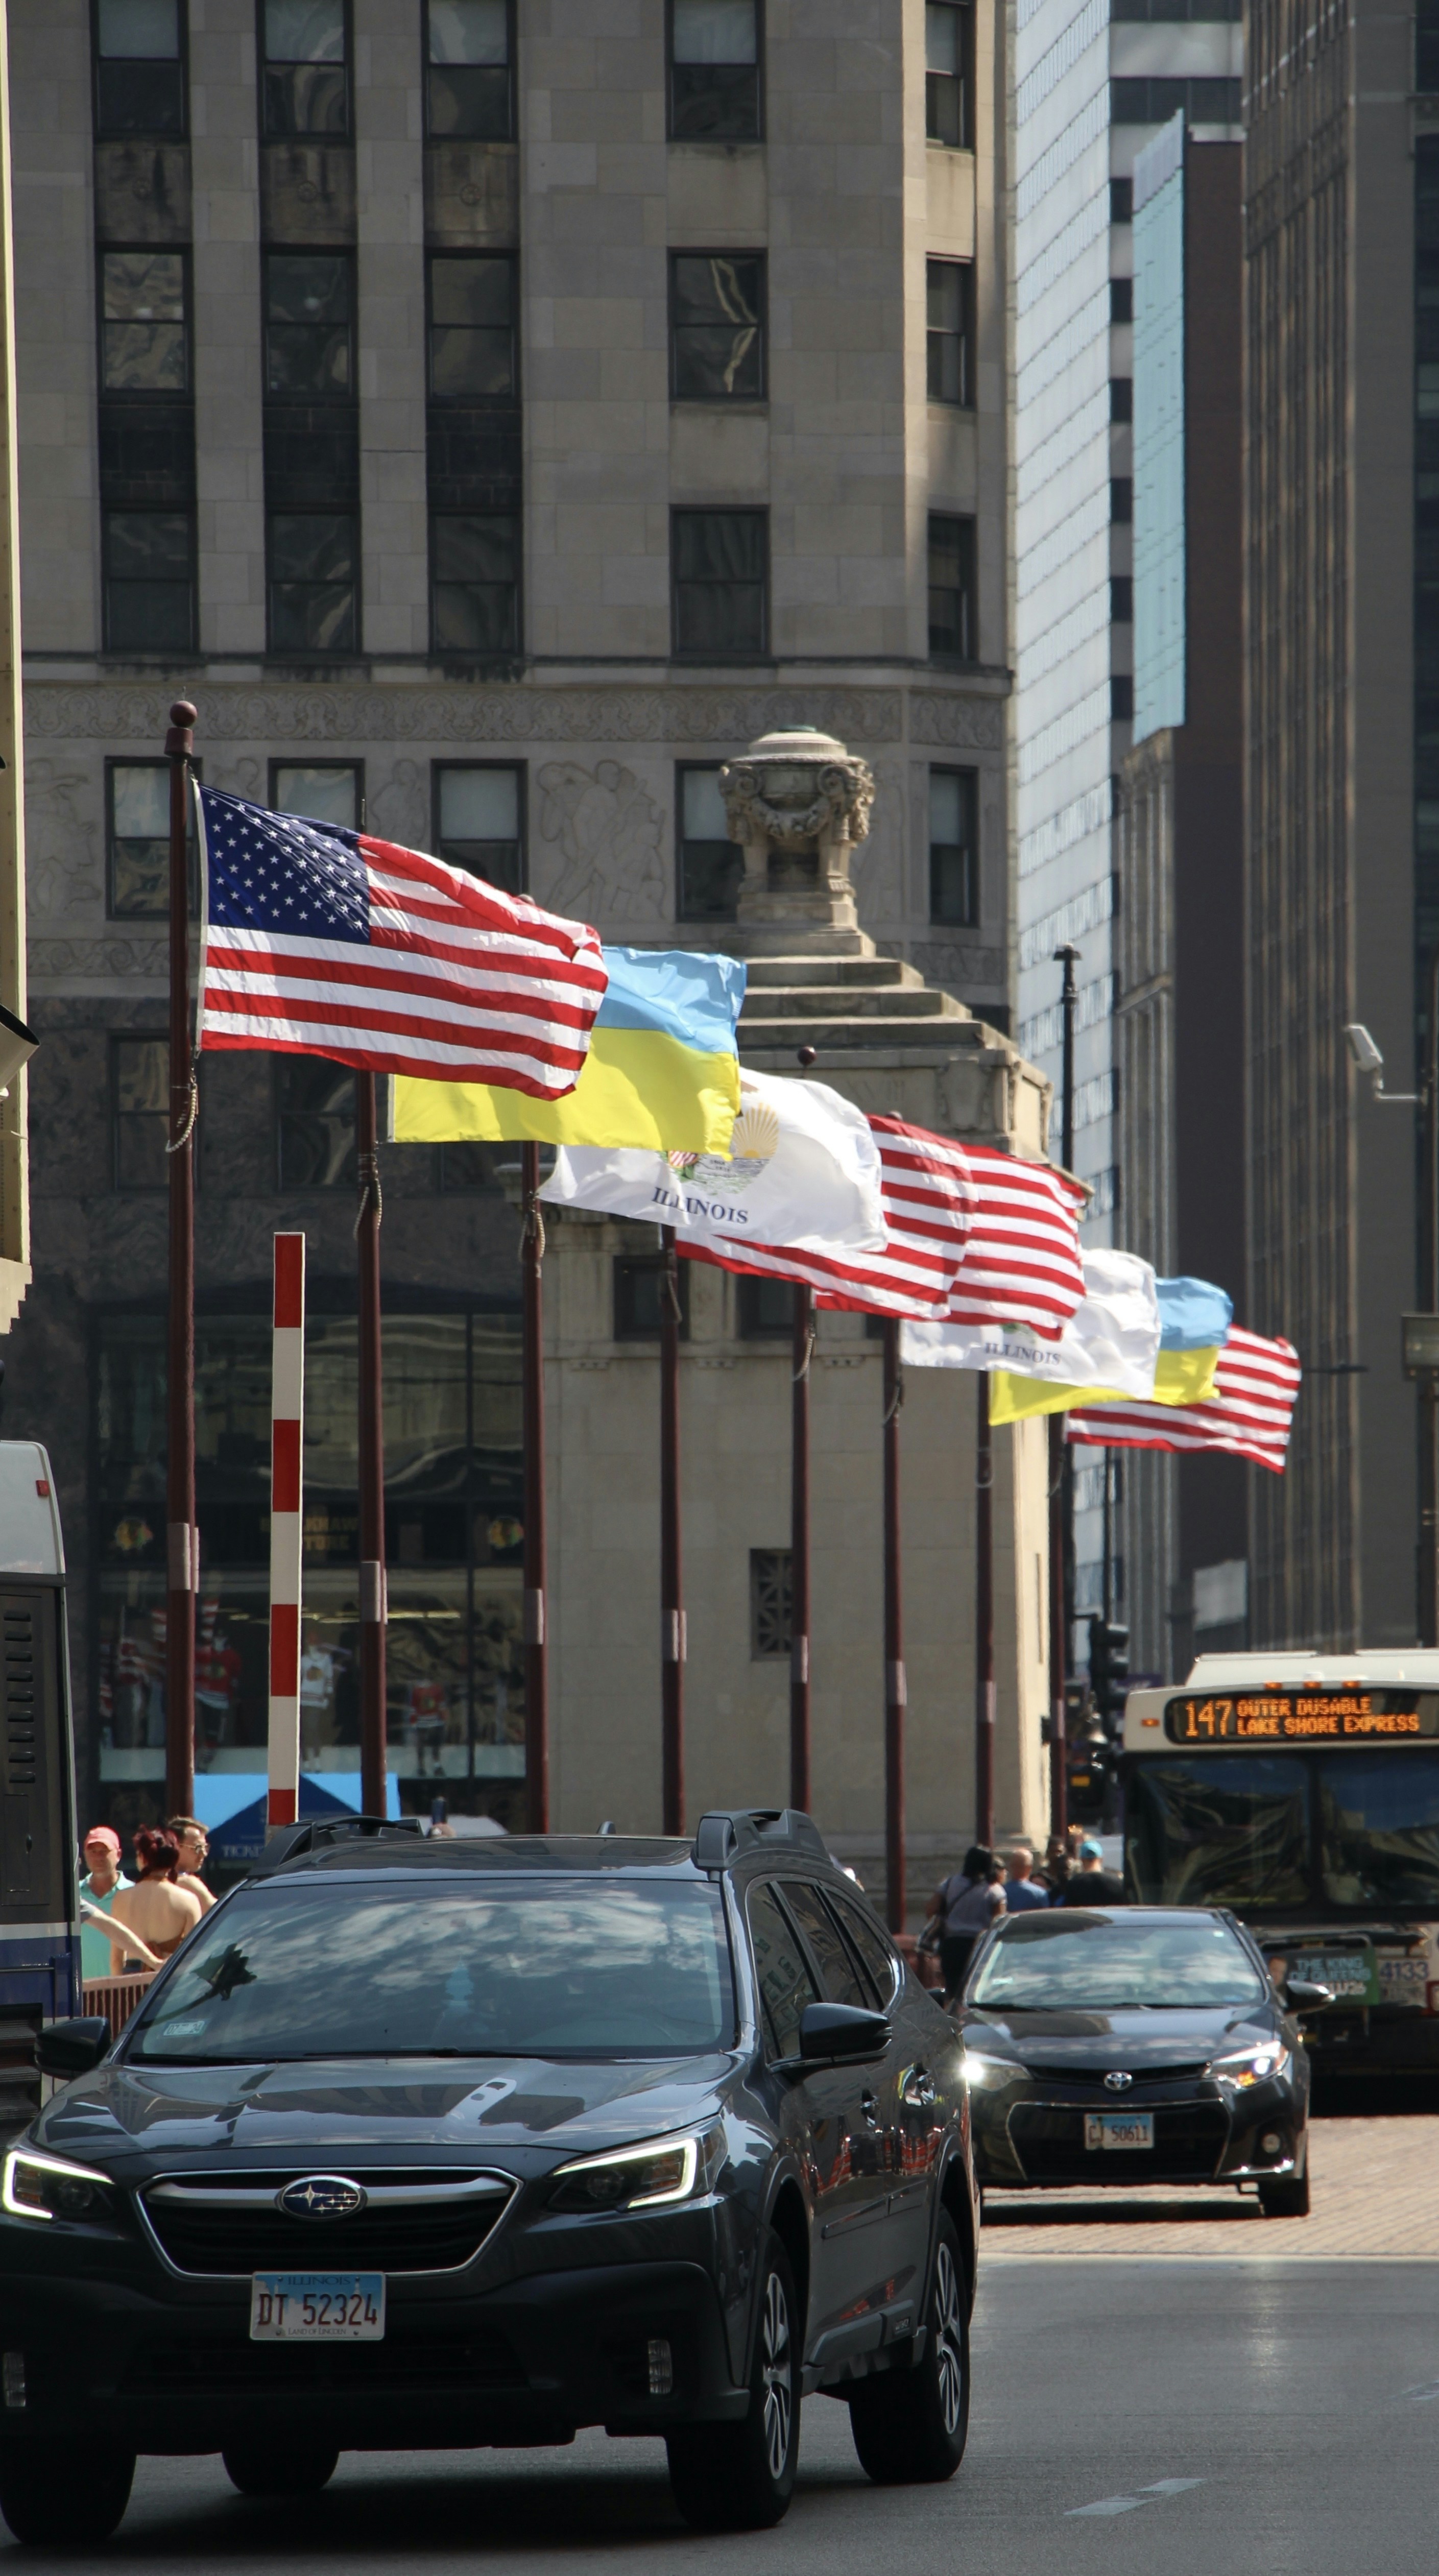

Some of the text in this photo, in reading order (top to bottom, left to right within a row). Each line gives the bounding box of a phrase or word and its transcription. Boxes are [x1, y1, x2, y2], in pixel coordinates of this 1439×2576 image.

[653, 1187, 748, 1224] ILLINOIS
[985, 1342, 1061, 1365] ILLINOIS
[1236, 1696, 1372, 1716] OUTER DUSABLE
[1185, 1699, 1233, 1736] 147
[1237, 1714, 1420, 1735] LAKE SHORE EXPRESS
[1296, 1955, 1364, 1971] THE KING
[1380, 1960, 1428, 1981] 4133
[1111, 2124, 1147, 2141] 50611
[288, 2277, 351, 2285] ILLINOIS
[258, 2293, 377, 2325] DT 52324
